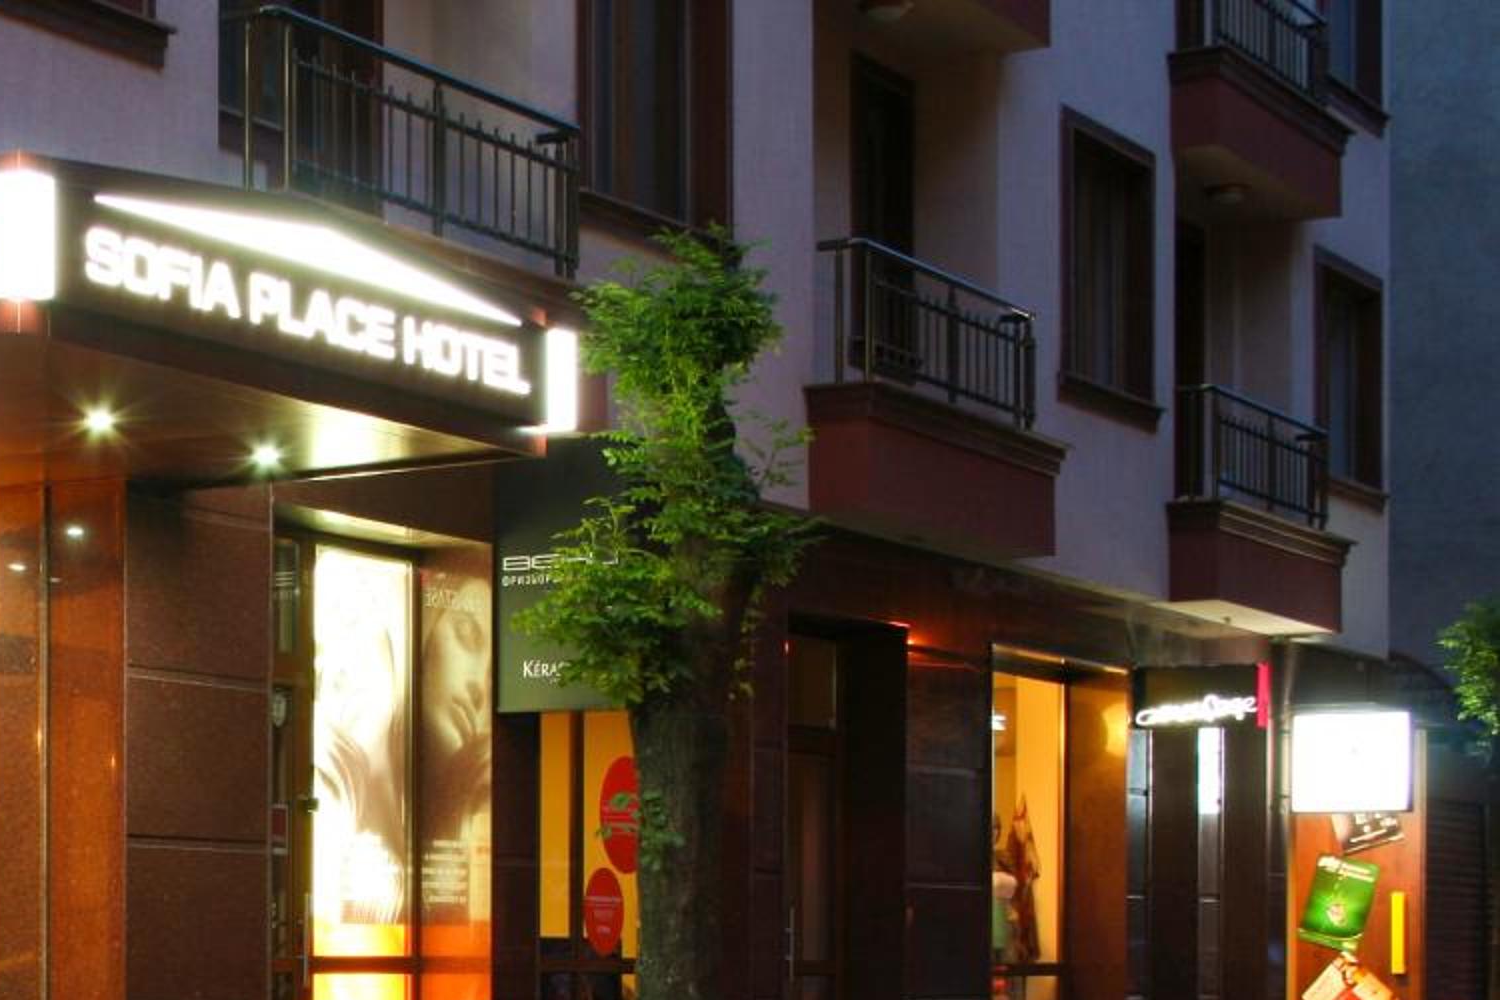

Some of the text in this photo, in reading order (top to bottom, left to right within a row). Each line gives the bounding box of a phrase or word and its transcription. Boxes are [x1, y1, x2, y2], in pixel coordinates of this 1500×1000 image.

[85, 225, 531, 396] SOFIA PLACE HOTEL
